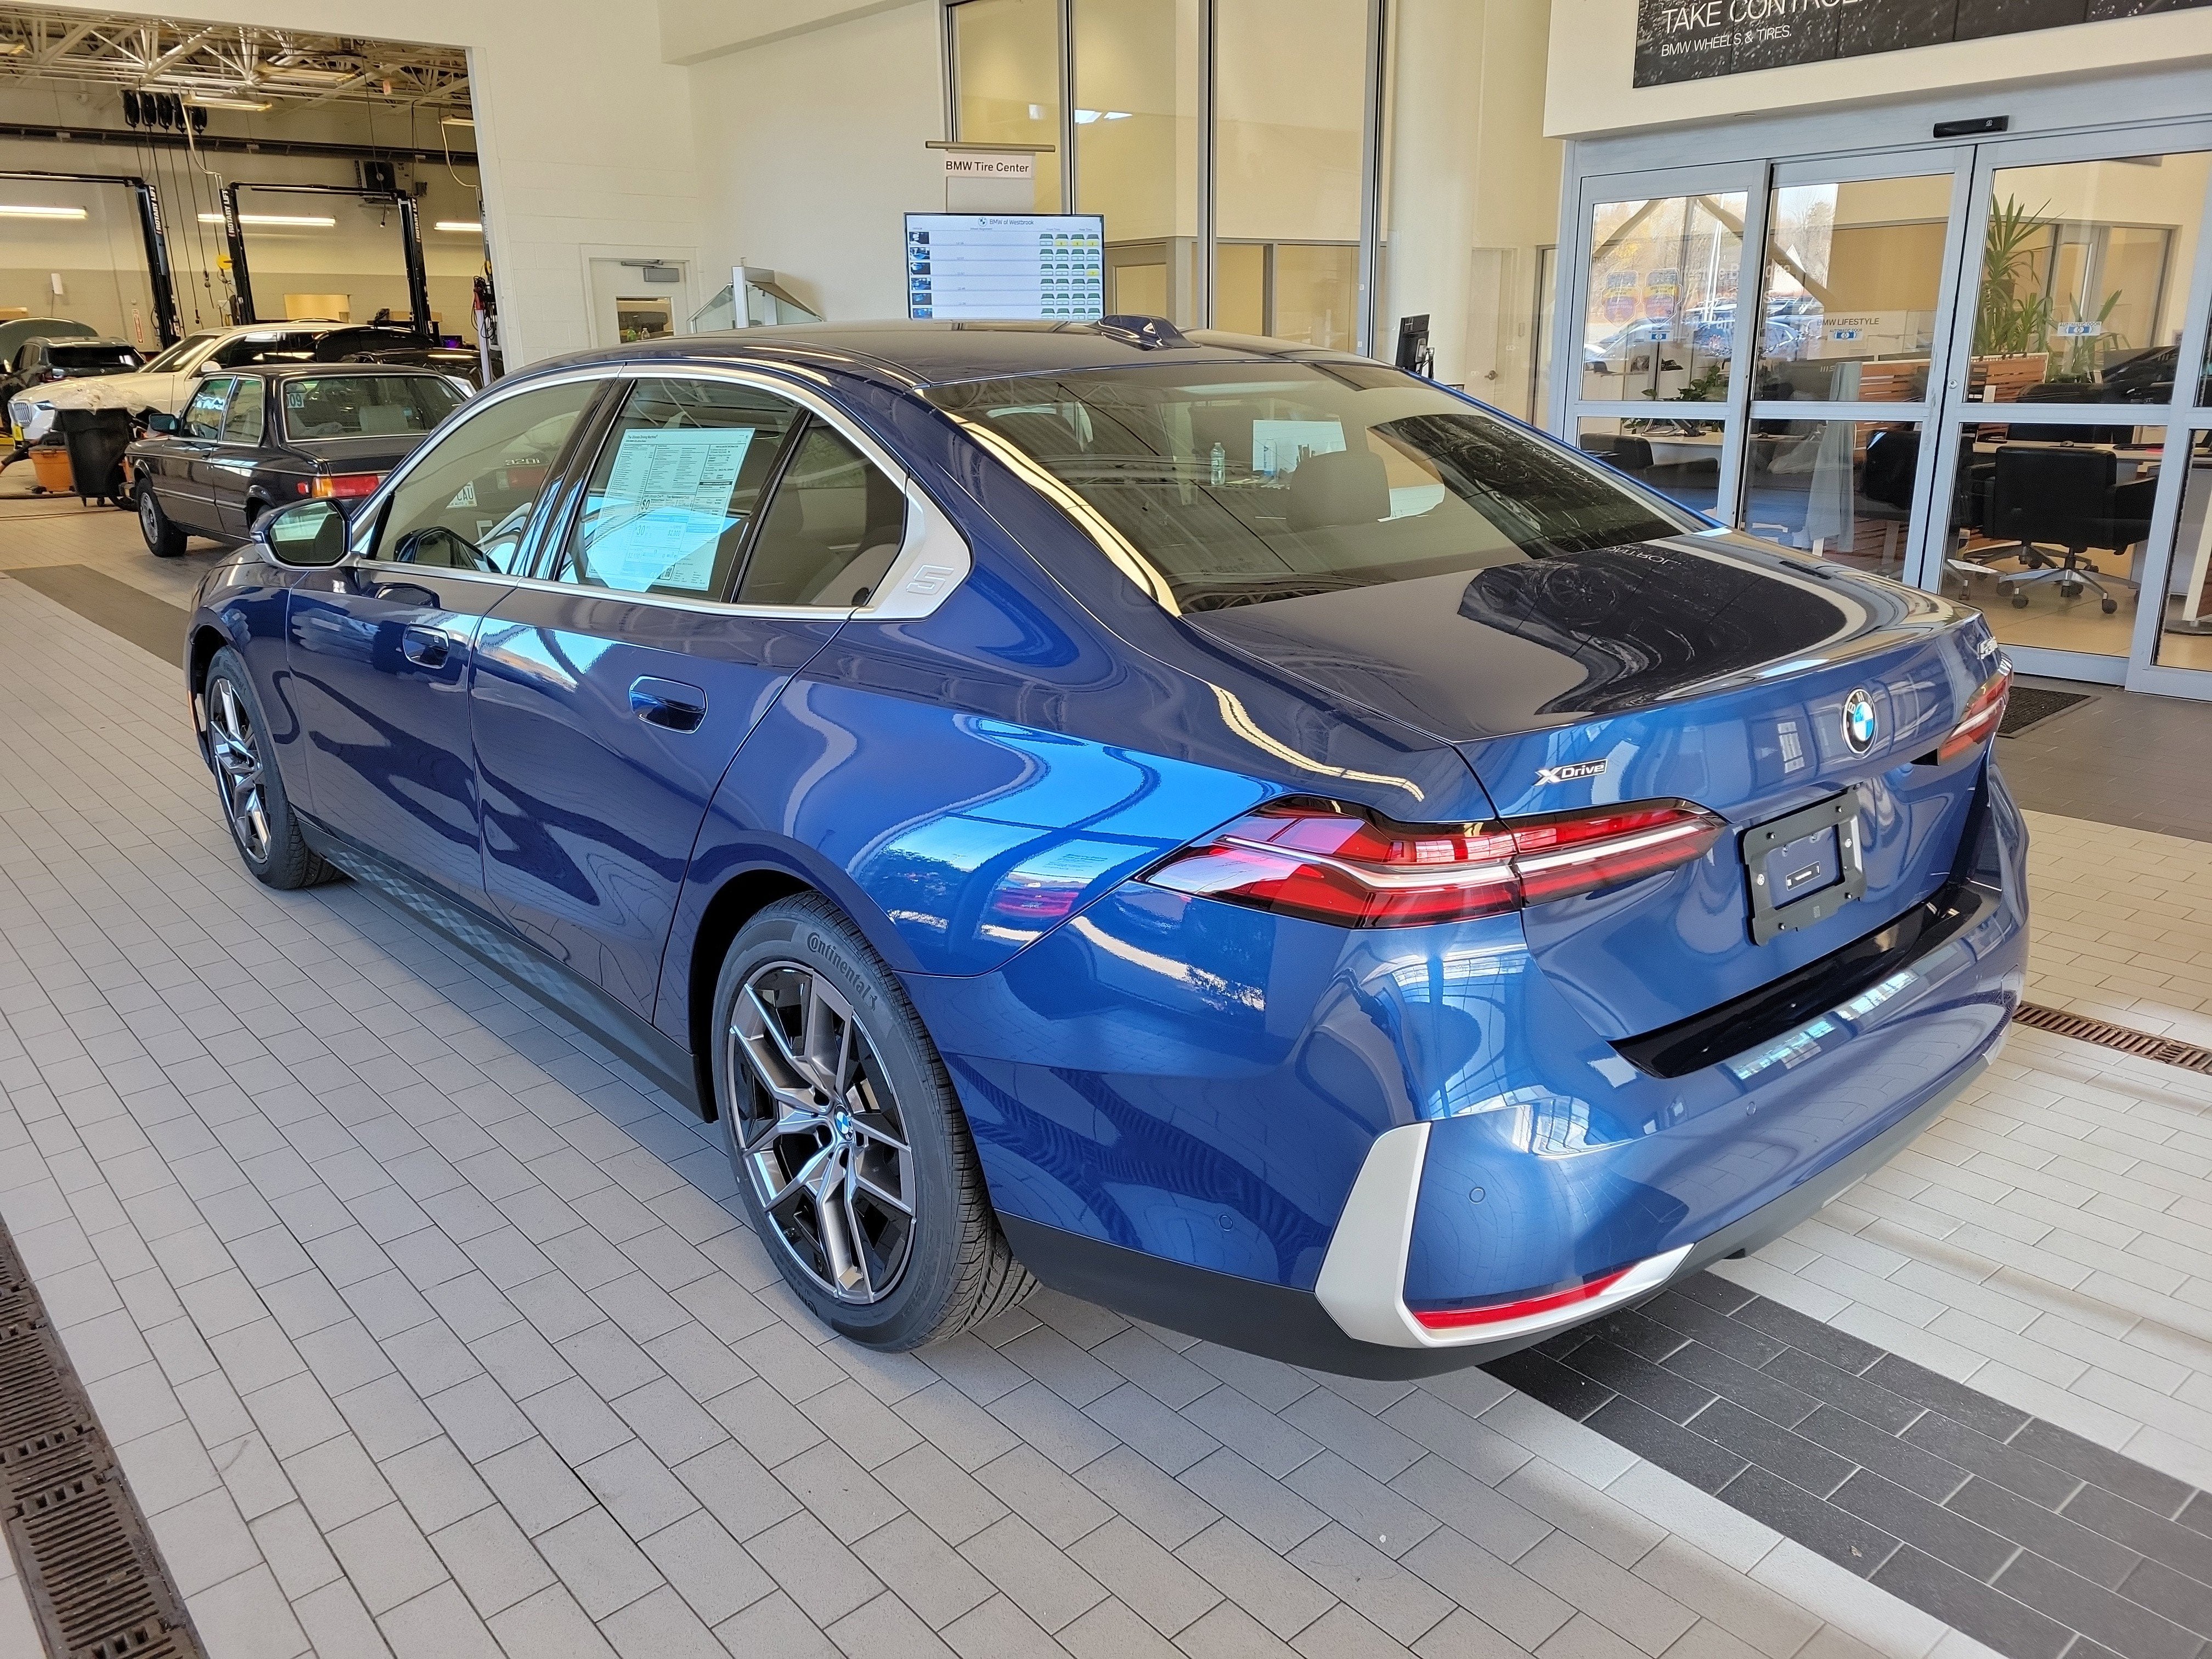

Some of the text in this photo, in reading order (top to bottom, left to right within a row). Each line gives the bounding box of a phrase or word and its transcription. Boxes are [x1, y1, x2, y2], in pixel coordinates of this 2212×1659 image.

[1662, 1, 1721, 34] TAKE
[1661, 25, 1792, 57] BMW WHEELS & TIRES.
[946, 161, 1029, 172] BMW Tire Center
[149, 185, 162, 230] ROTARY LIFT
[222, 190, 235, 233] ROTARY LIFT
[806, 932, 871, 1001] Continental
